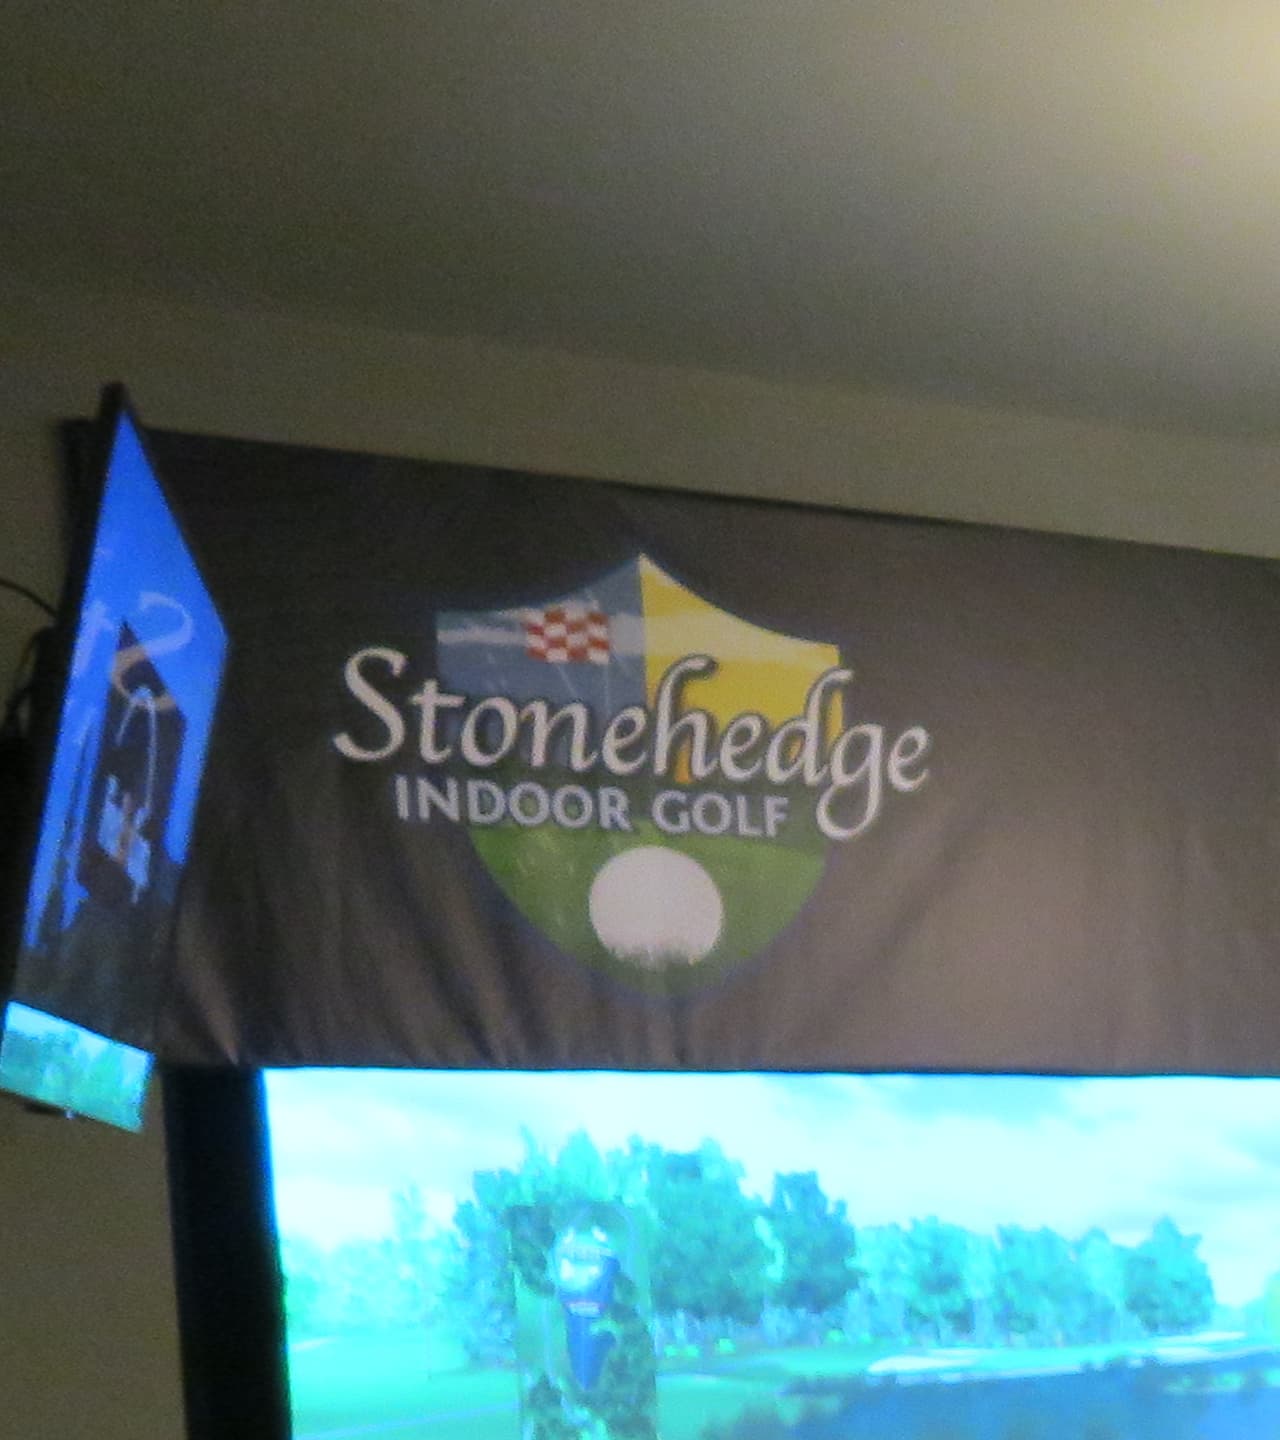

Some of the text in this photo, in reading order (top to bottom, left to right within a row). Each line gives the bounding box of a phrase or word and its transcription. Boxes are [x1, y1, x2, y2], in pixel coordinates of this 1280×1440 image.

[333, 646, 932, 840] Stonehedge
[394, 775, 790, 837] INDOOR GOLF
